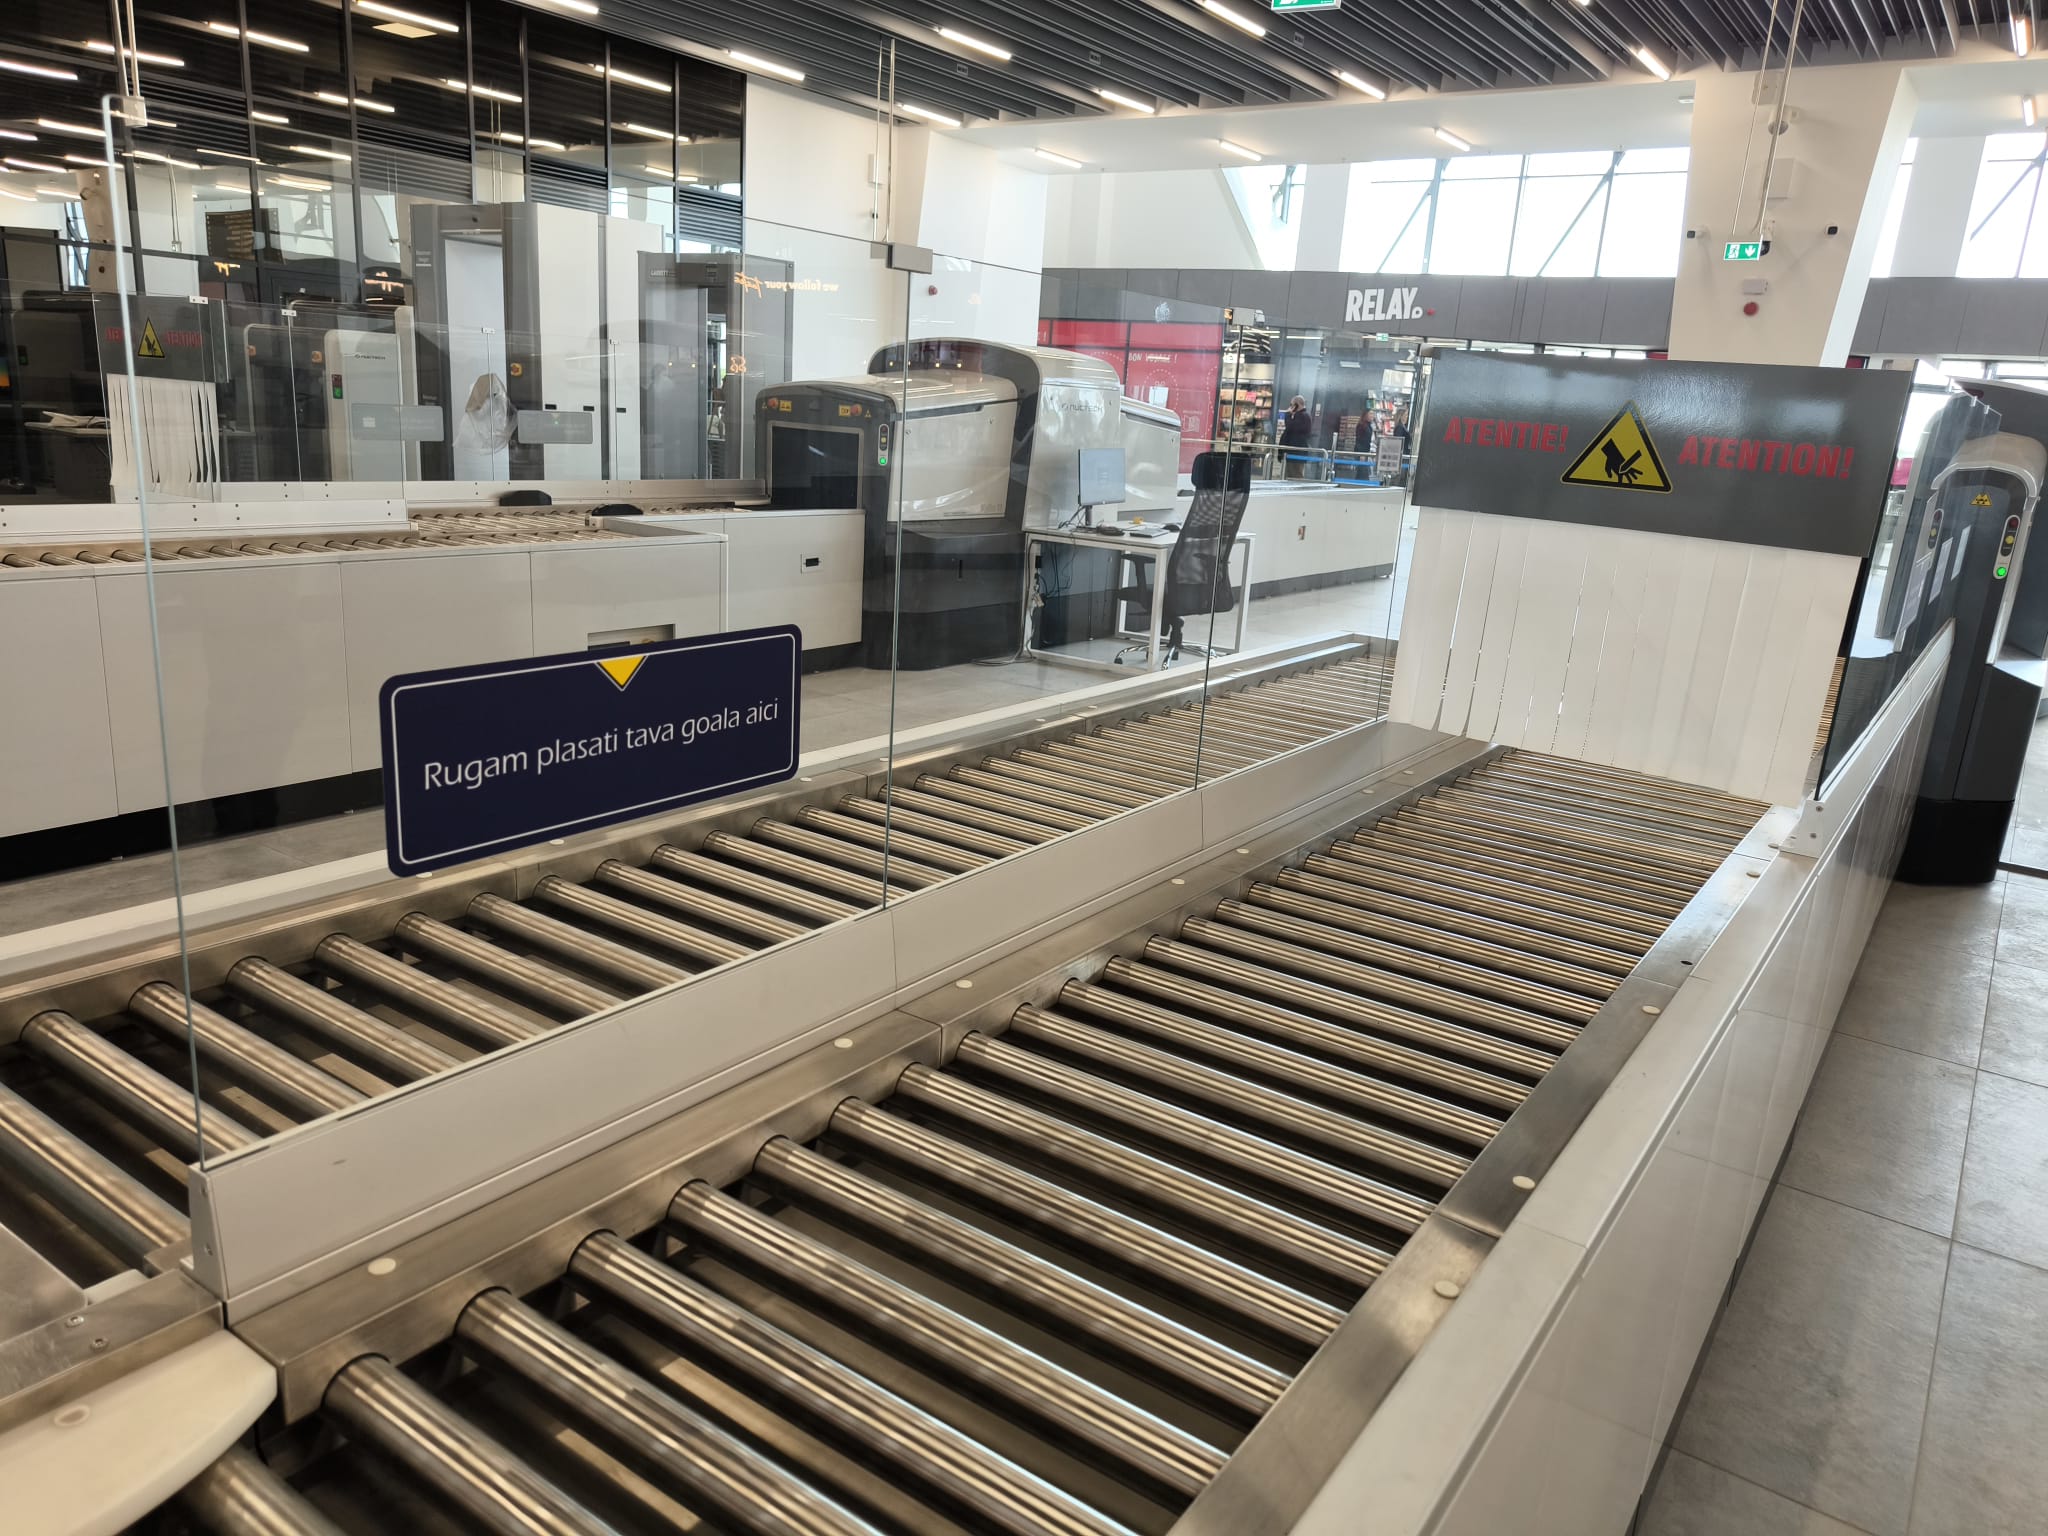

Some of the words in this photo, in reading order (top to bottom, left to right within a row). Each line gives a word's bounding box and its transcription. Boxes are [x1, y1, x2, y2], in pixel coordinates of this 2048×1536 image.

[1443, 416, 1569, 454] ATENTIE!
[1678, 435, 1855, 479] ATENTION!
[424, 751, 528, 791] Rugam
[537, 727, 618, 776] plasati
[625, 723, 674, 749] tava
[681, 707, 740, 745] goala
[746, 697, 778, 725] aici
